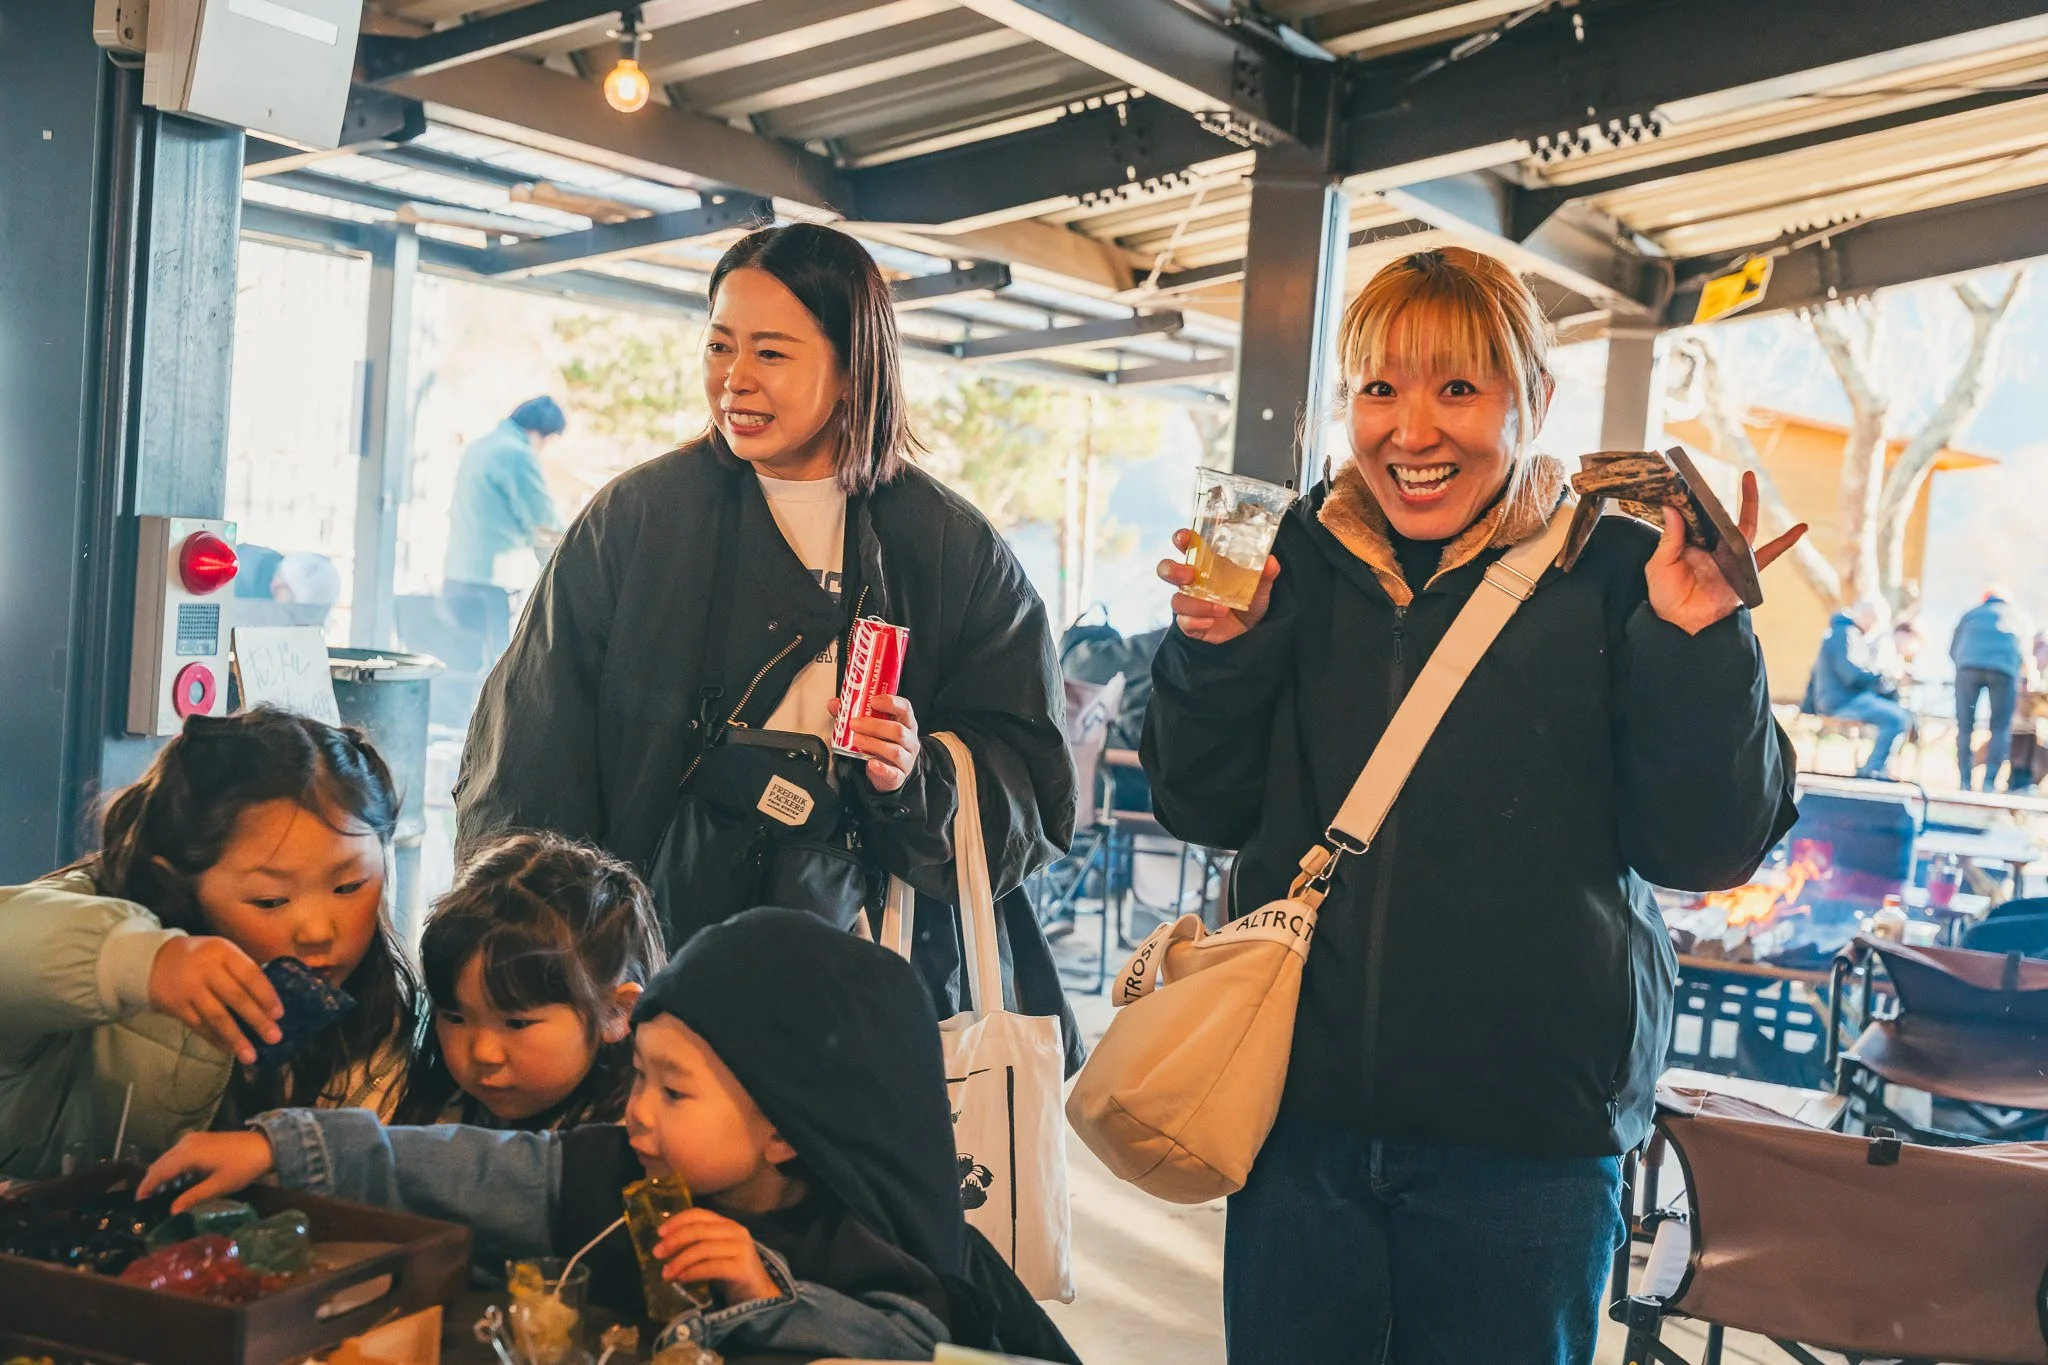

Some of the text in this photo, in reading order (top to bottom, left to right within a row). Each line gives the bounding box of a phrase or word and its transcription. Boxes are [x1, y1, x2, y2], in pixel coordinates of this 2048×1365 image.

[864, 658, 882, 717] RIGINAL TASTE
[769, 790, 806, 813] PACKERS
[772, 784, 807, 806] FREDRIK
